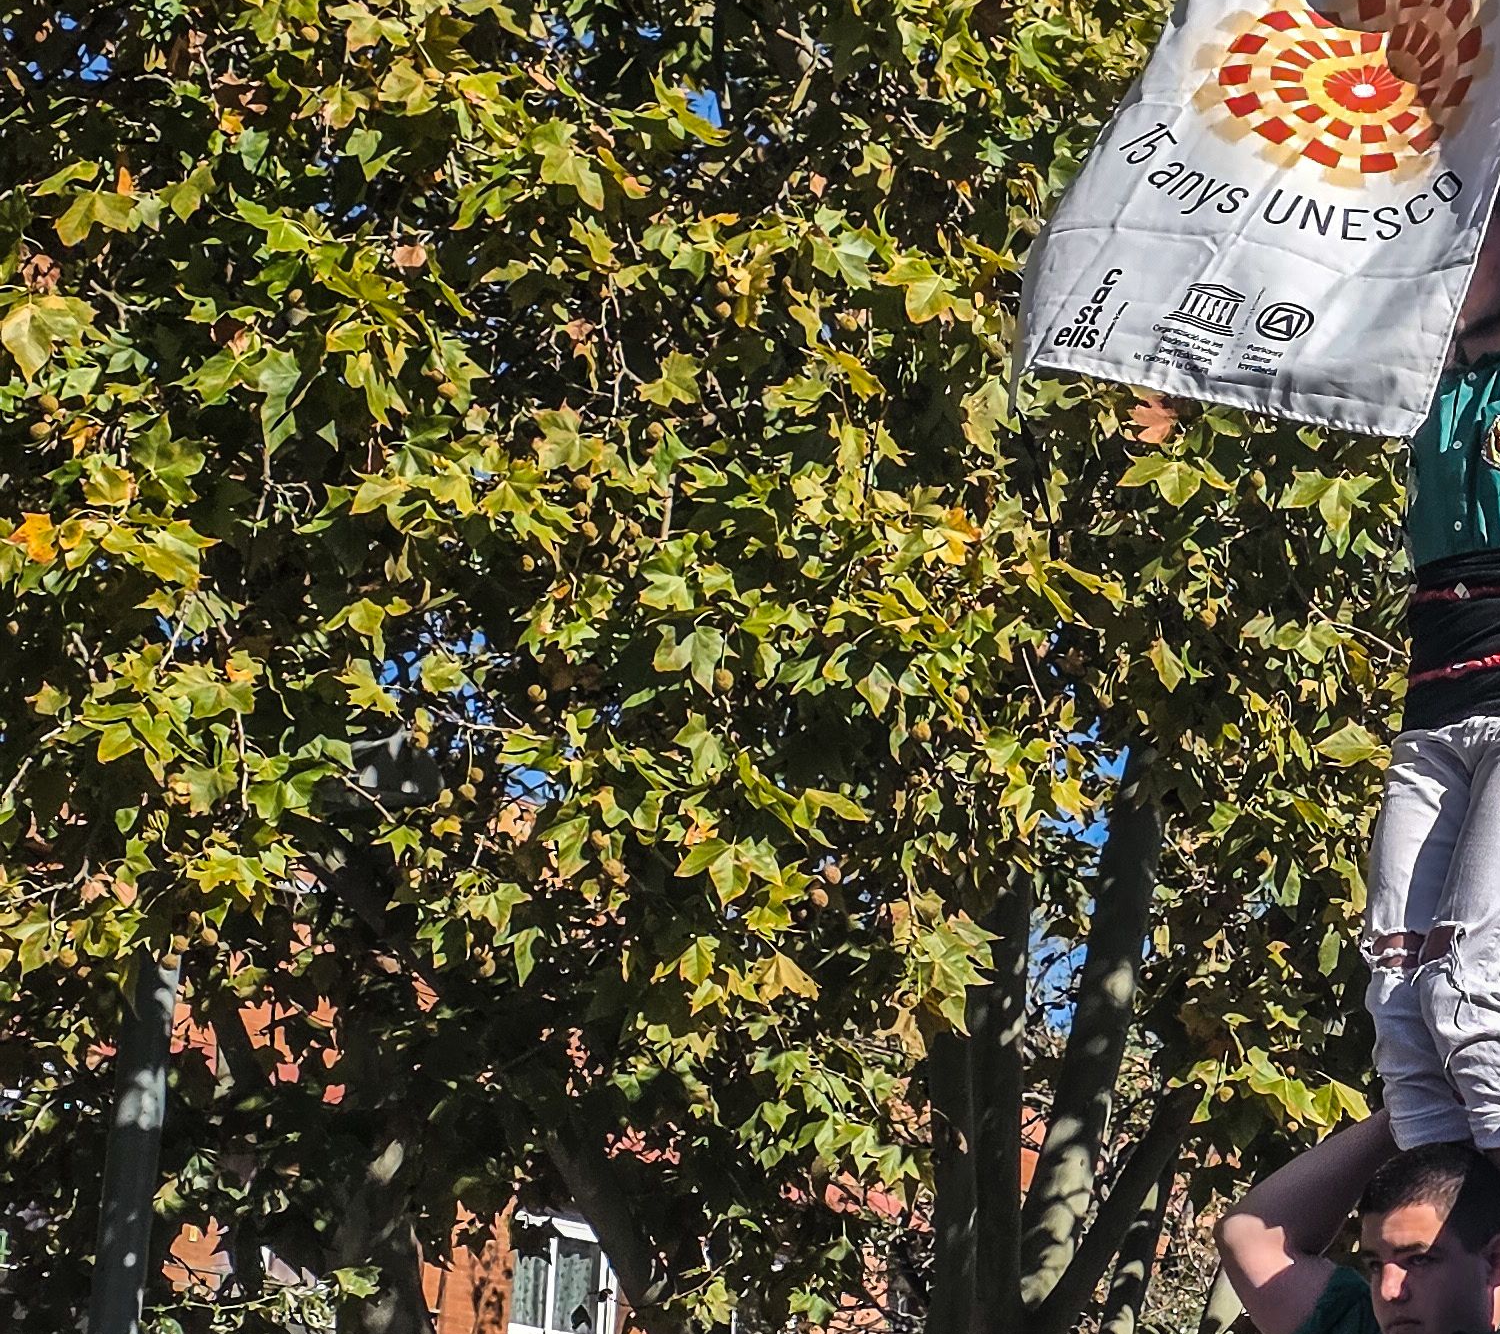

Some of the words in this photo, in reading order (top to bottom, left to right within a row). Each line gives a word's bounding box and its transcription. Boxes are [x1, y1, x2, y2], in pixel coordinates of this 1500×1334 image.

[1118, 122, 1178, 165] 15
[1147, 161, 1249, 215] anys
[1262, 170, 1463, 241] UNESCO
